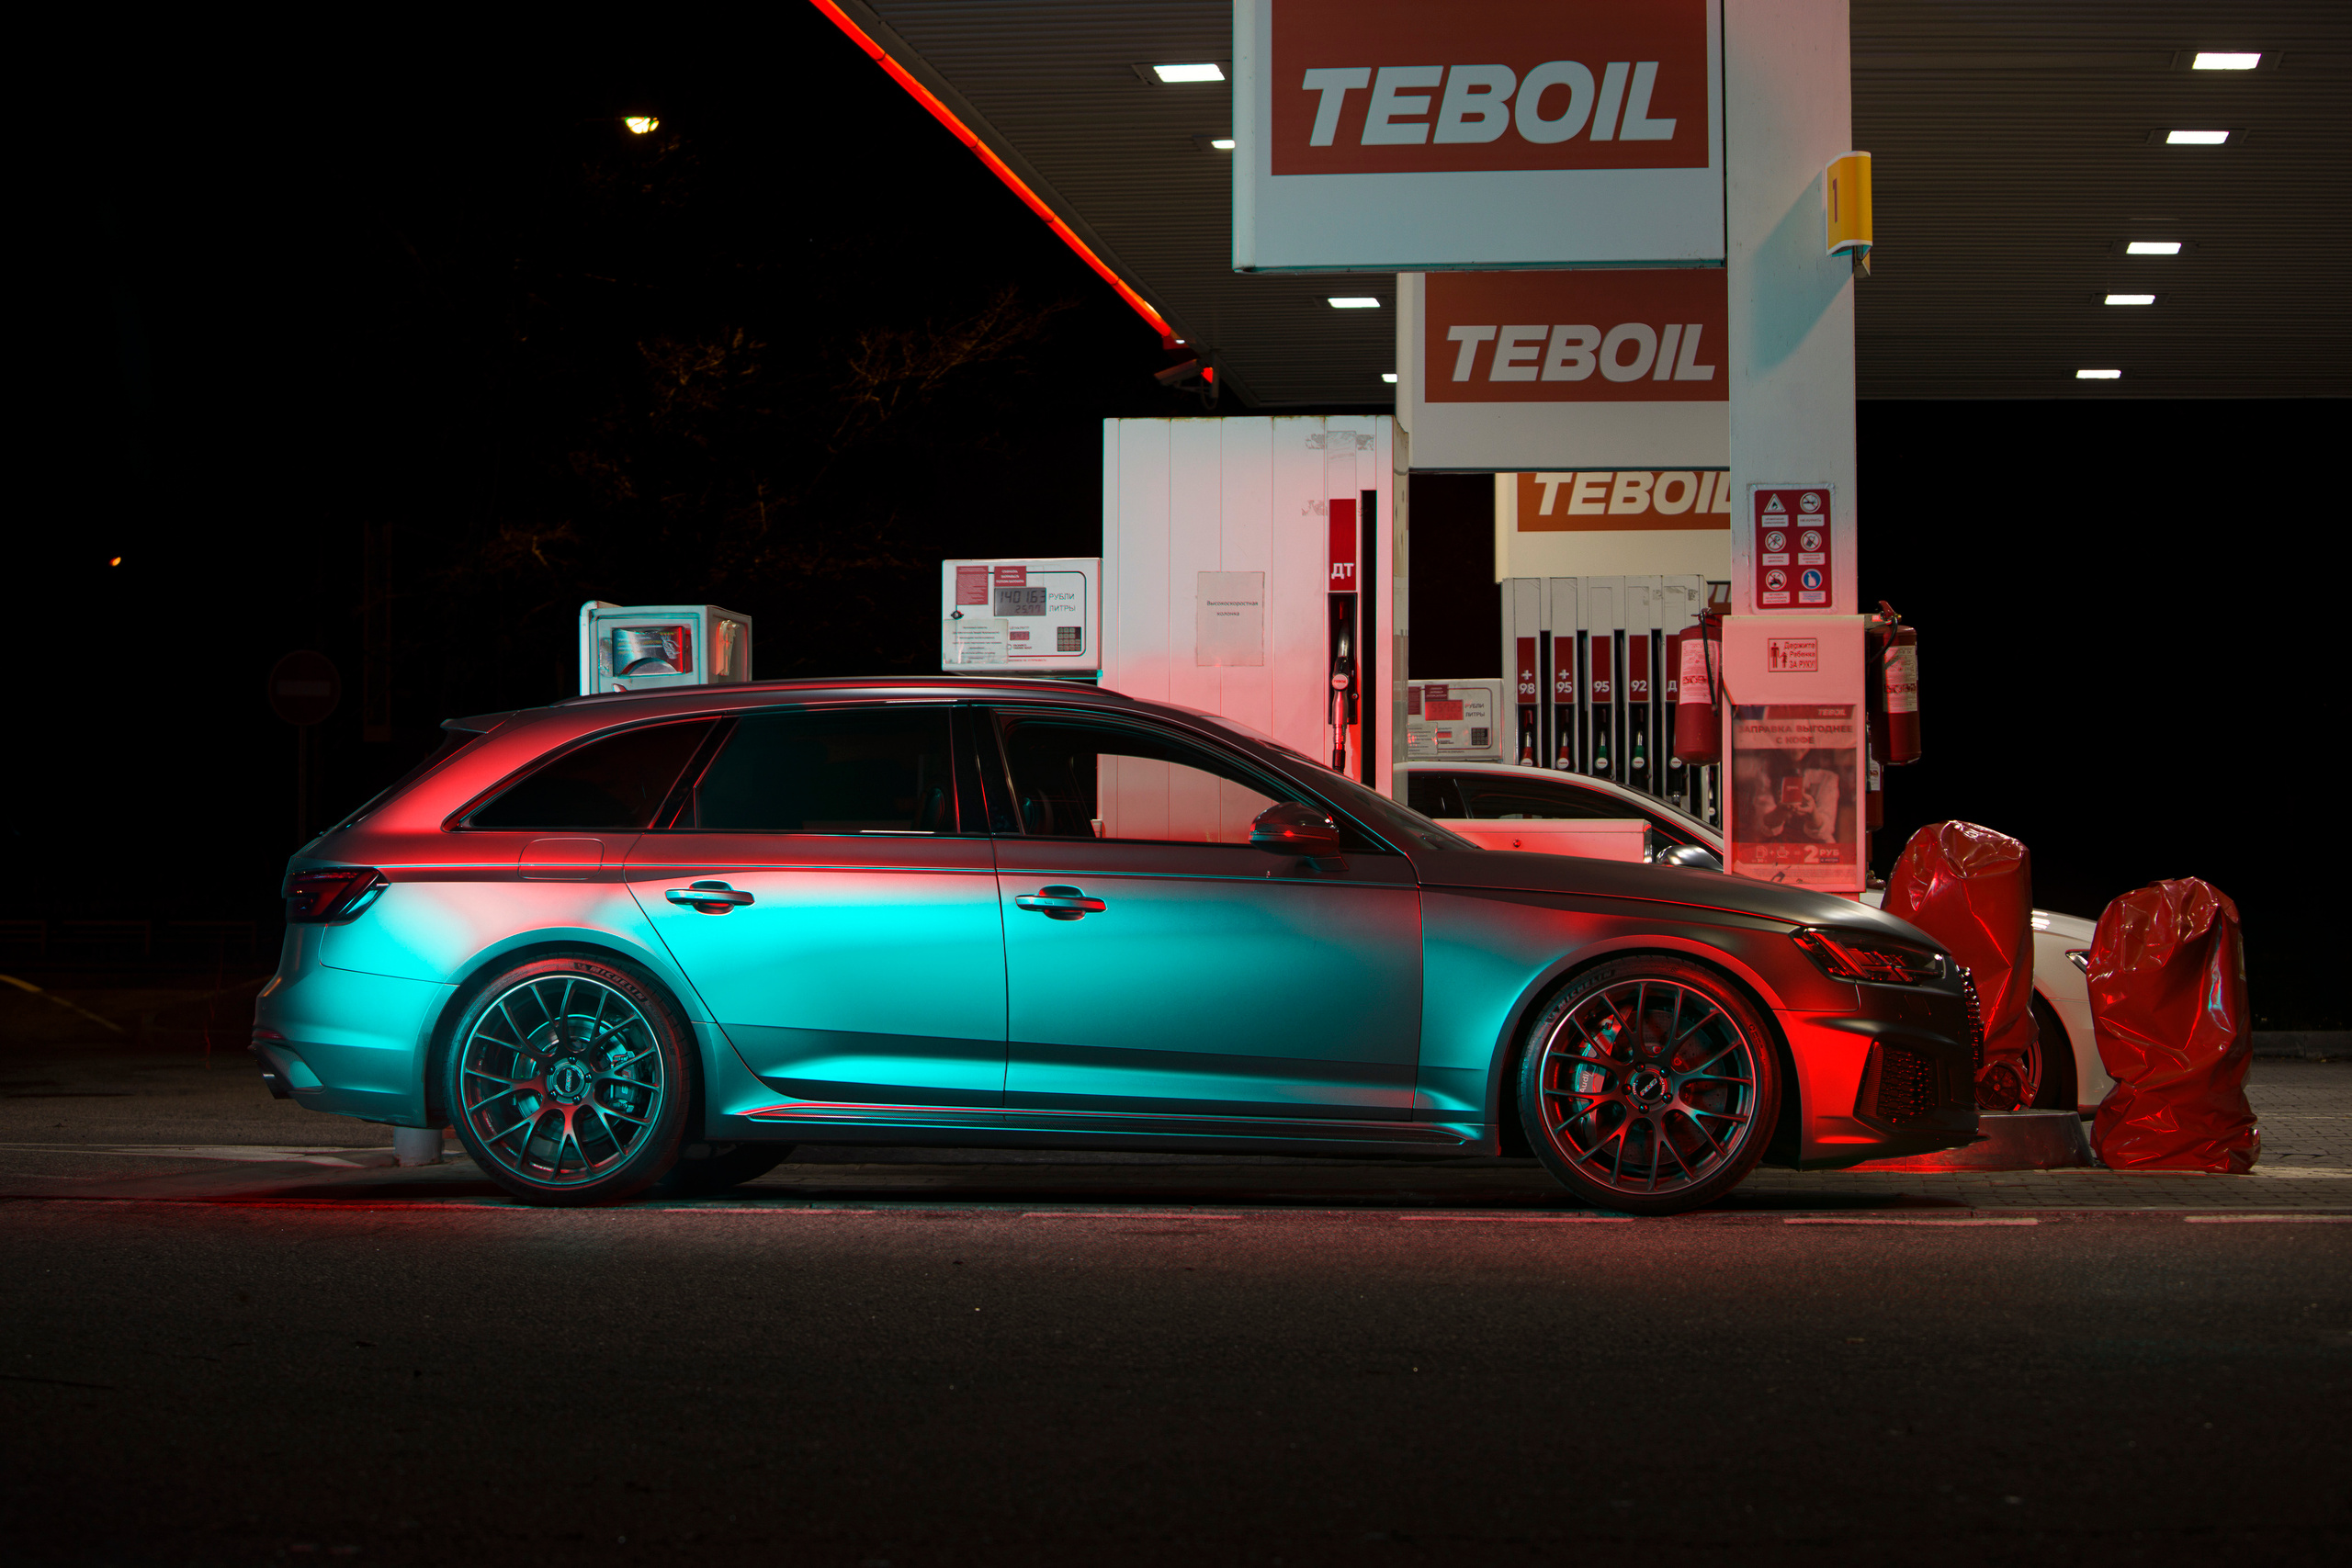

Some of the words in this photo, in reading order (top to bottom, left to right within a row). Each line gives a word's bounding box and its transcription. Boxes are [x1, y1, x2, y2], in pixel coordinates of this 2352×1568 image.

[1302, 61, 1677, 146] TEBOIL
[1832, 177, 1838, 224] 1
[1446, 322, 1715, 382] TEBOIL
[1331, 562, 1354, 580] ДТ
[1783, 641, 1815, 650] Держите
[1789, 660, 1797, 669] ЗА
[1519, 682, 1535, 694] 98
[1556, 682, 1573, 694] 95
[1593, 681, 1610, 693] 95
[1631, 680, 1646, 692] 92
[1667, 680, 1678, 693] Д
[1817, 708, 1847, 716] TEBOIL
[1738, 725, 1792, 734] ЗАПРАВКА
[1795, 725, 1853, 734] ВЫГОДНЕЕ
[1775, 736, 1782, 744] С
[1784, 736, 1815, 744] КОФЕ
[1804, 844, 1819, 863] 2
[589, 965, 646, 1000] MICHELIN
[1579, 1073, 1589, 1093] Audi
